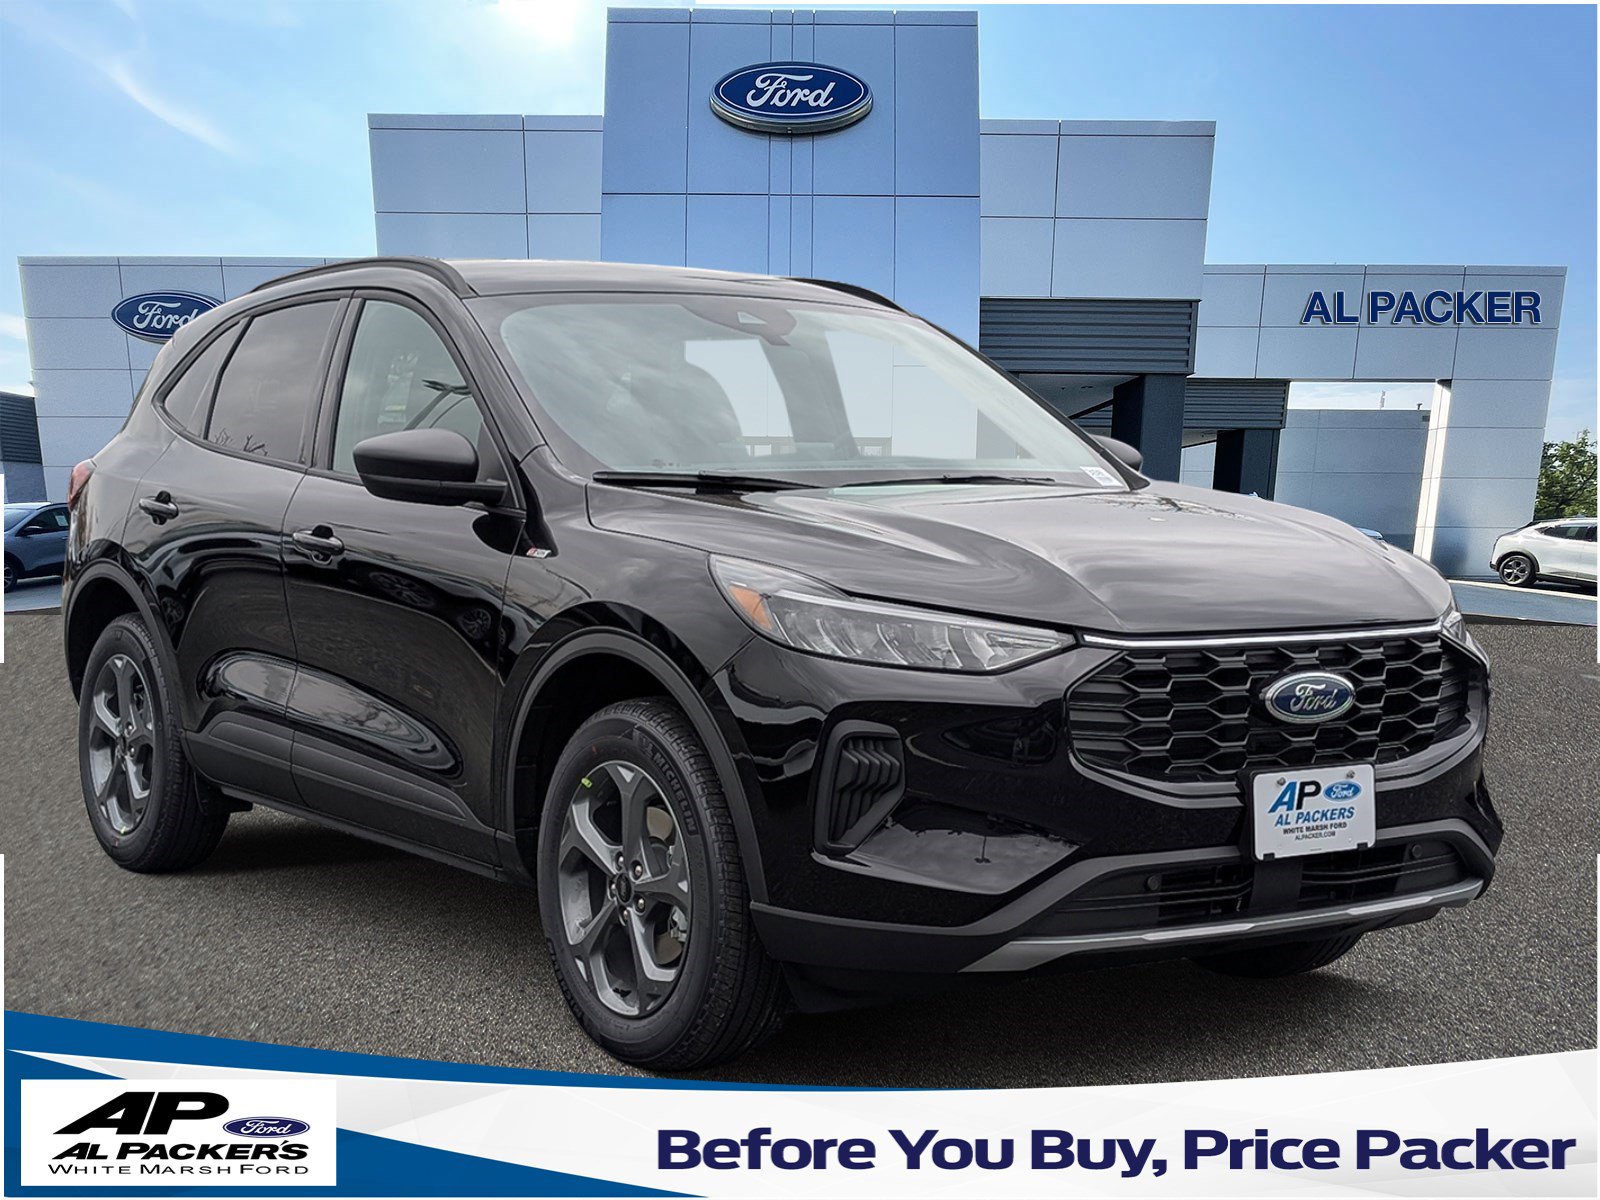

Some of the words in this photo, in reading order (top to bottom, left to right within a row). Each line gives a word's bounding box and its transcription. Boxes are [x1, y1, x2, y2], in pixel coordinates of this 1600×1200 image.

[746, 73, 836, 107] Ford
[1302, 290, 1360, 324] AL
[1368, 290, 1542, 325] PACKER
[1290, 683, 1338, 712] Ford
[653, 752, 698, 833] MICHELIN
[1267, 780, 1322, 814] AP
[1330, 784, 1355, 798] Ford
[1275, 814, 1291, 827] AL
[1296, 806, 1355, 824] PACKERS
[1283, 827, 1304, 835] WHITE
[1305, 825, 1328, 833] MARSH
[1295, 831, 1336, 841] ALPACKER.COM
